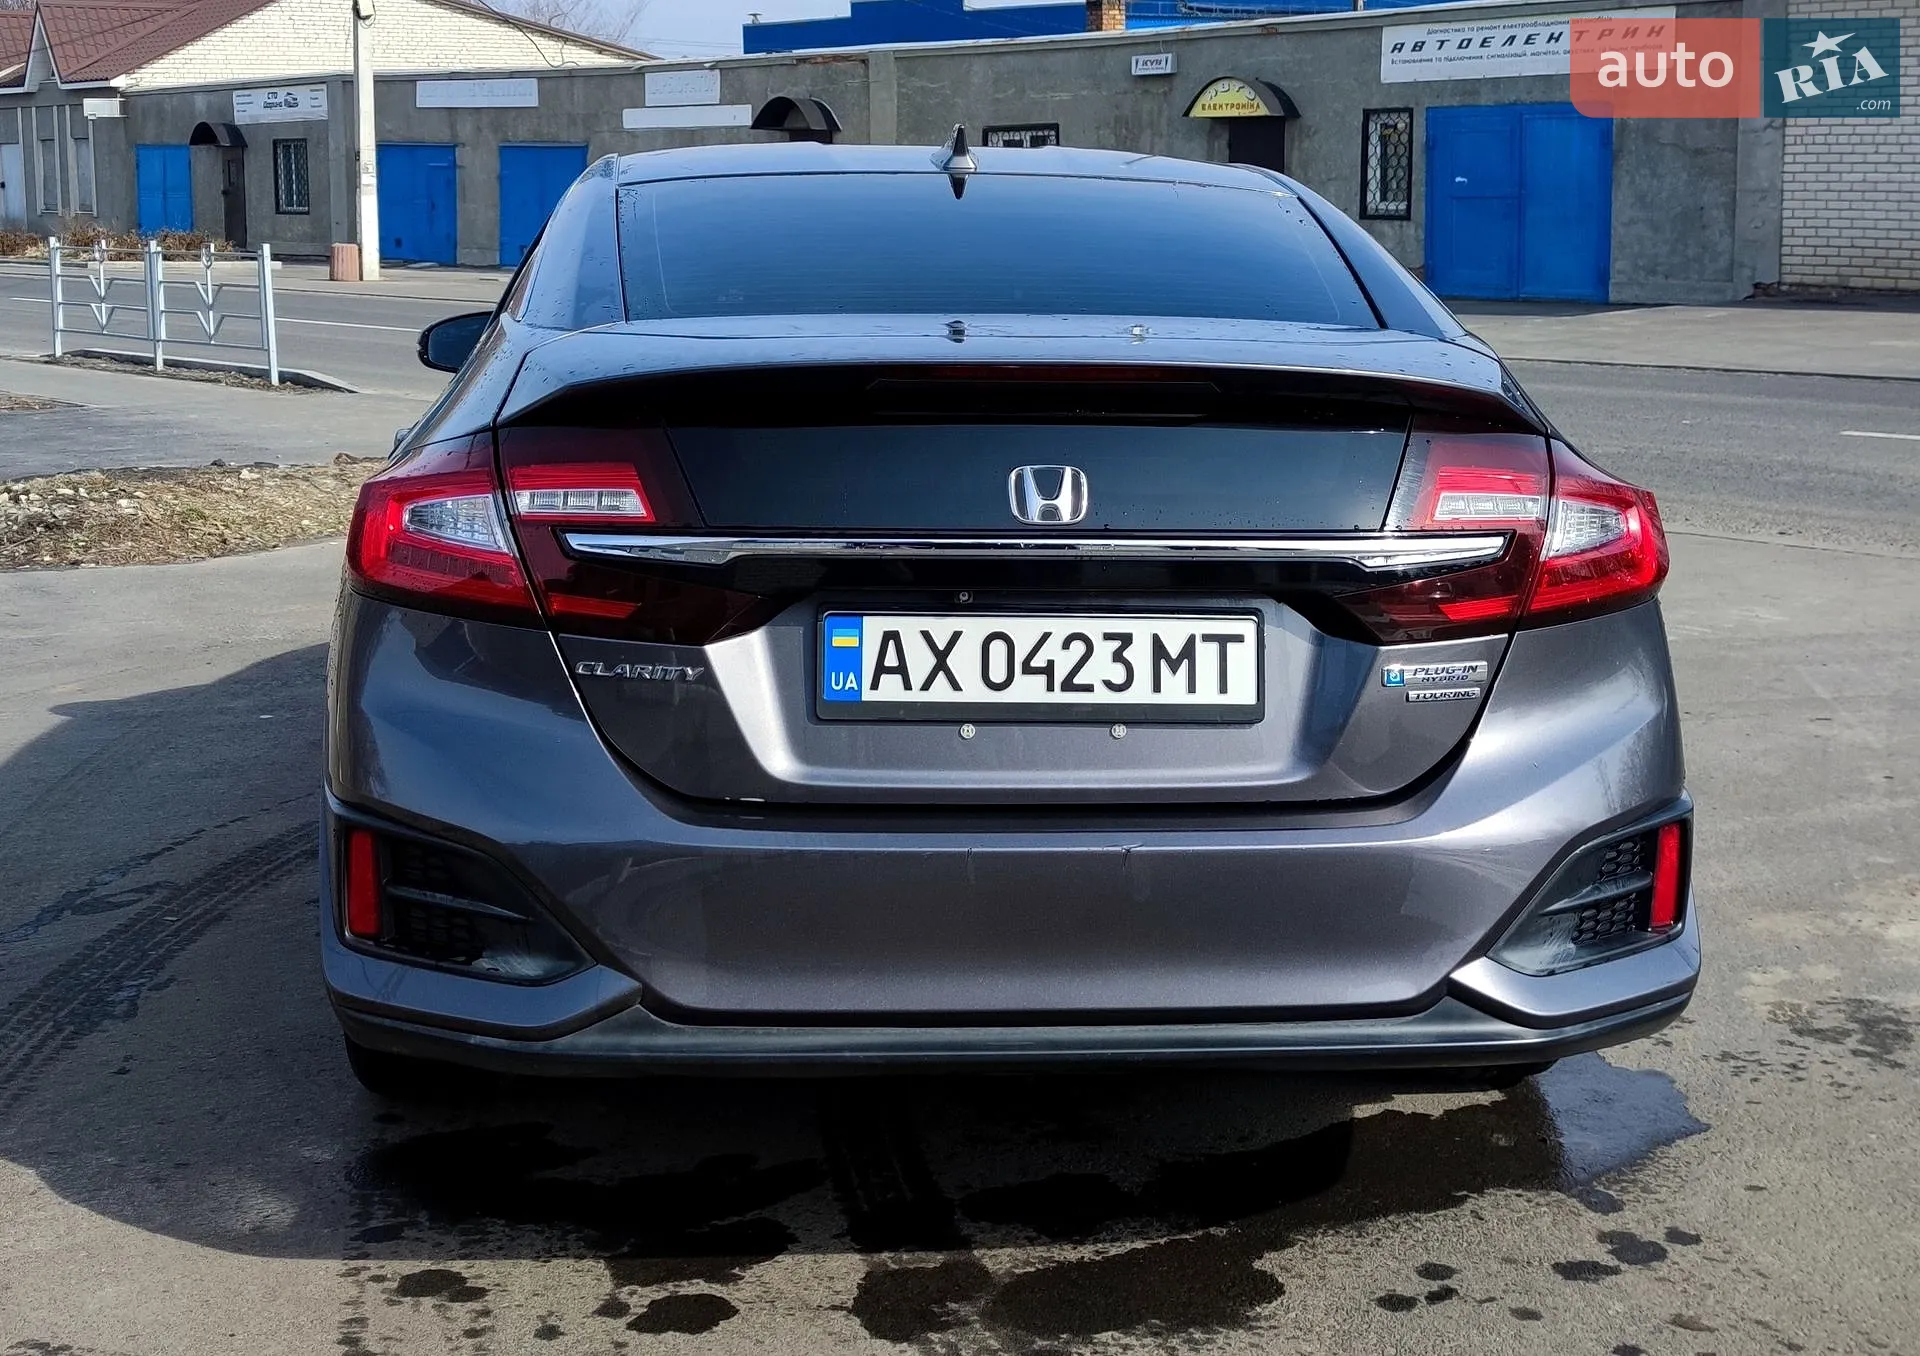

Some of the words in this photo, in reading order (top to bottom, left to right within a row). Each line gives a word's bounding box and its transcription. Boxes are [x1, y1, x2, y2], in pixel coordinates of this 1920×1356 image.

[869, 629, 964, 692] AX
[980, 631, 1135, 694] 0423
[1152, 633, 1246, 694] MT
[575, 661, 705, 681] CLARITY
[1412, 664, 1479, 676] PLUG-IN
[830, 671, 858, 690] UA
[1421, 674, 1469, 682] HYBRID
[1413, 689, 1476, 700] TOURING
